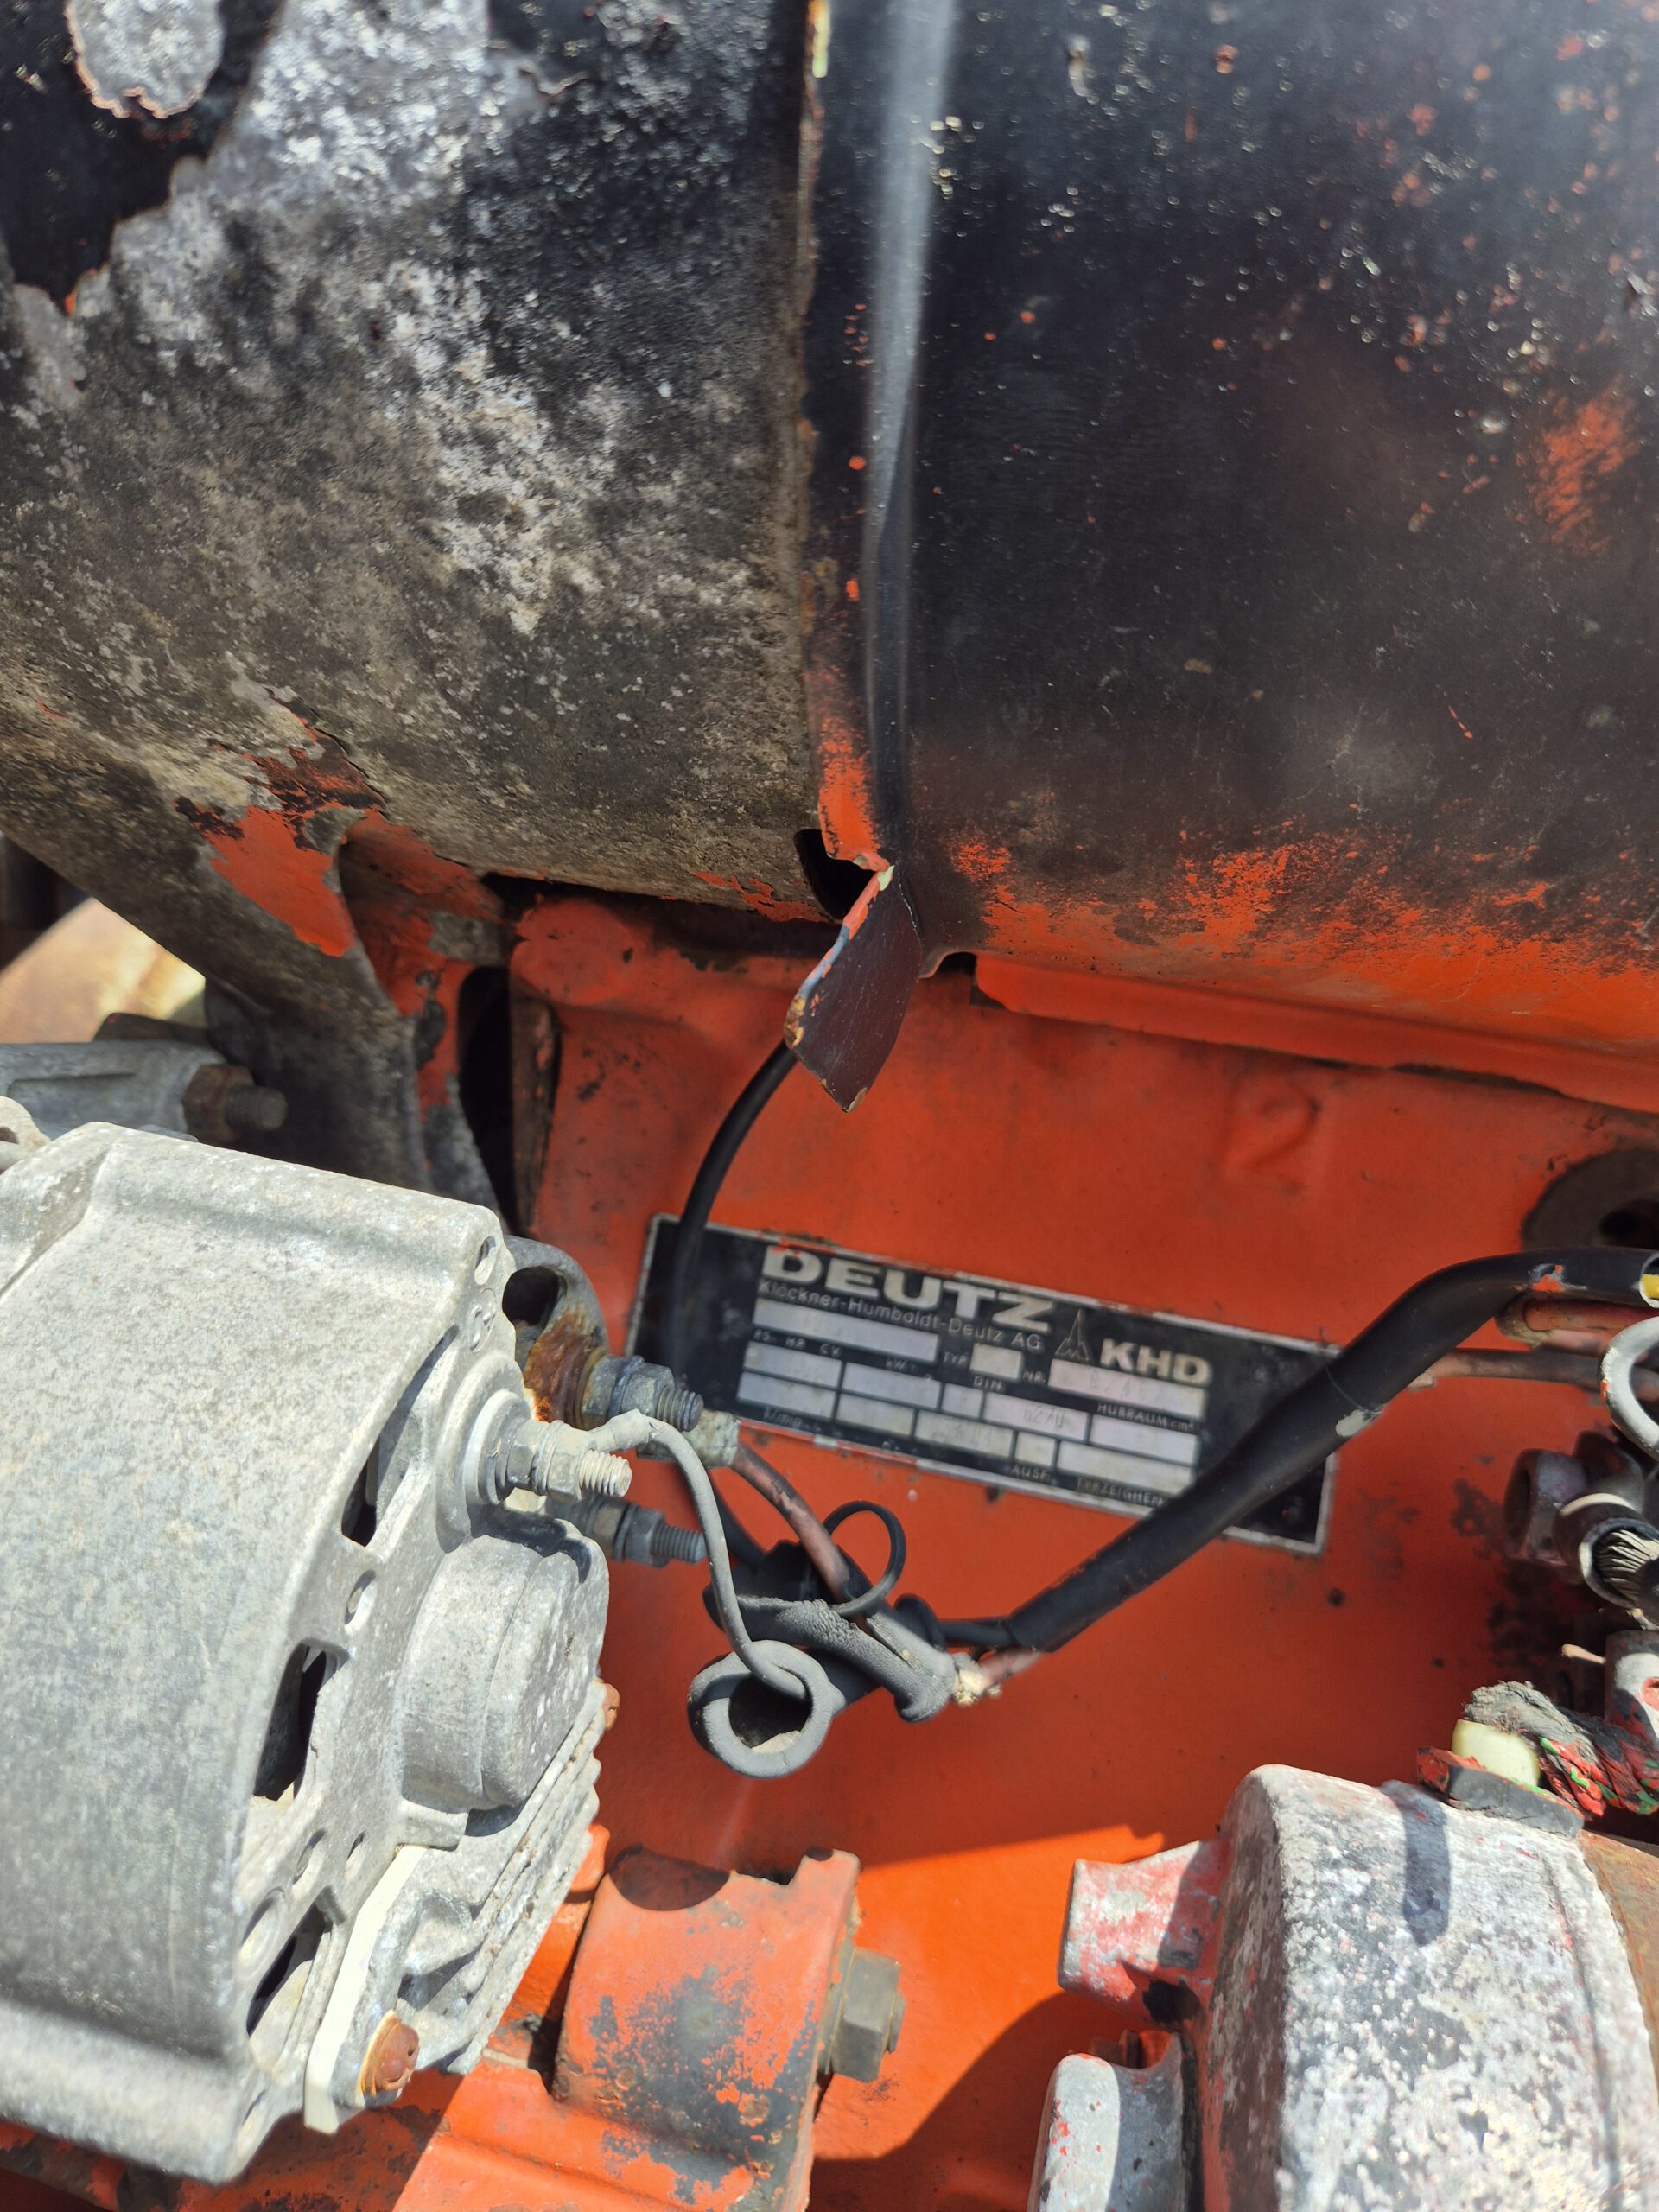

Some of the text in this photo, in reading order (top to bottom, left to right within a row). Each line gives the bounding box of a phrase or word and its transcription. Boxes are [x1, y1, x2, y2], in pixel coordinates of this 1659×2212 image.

[762, 1246, 1053, 1332] DEUTZ
[1011, 1331, 1045, 1351] AG
[1101, 1338, 1211, 1385] KHD
[1097, 1401, 1167, 1428] HUBRAUM
